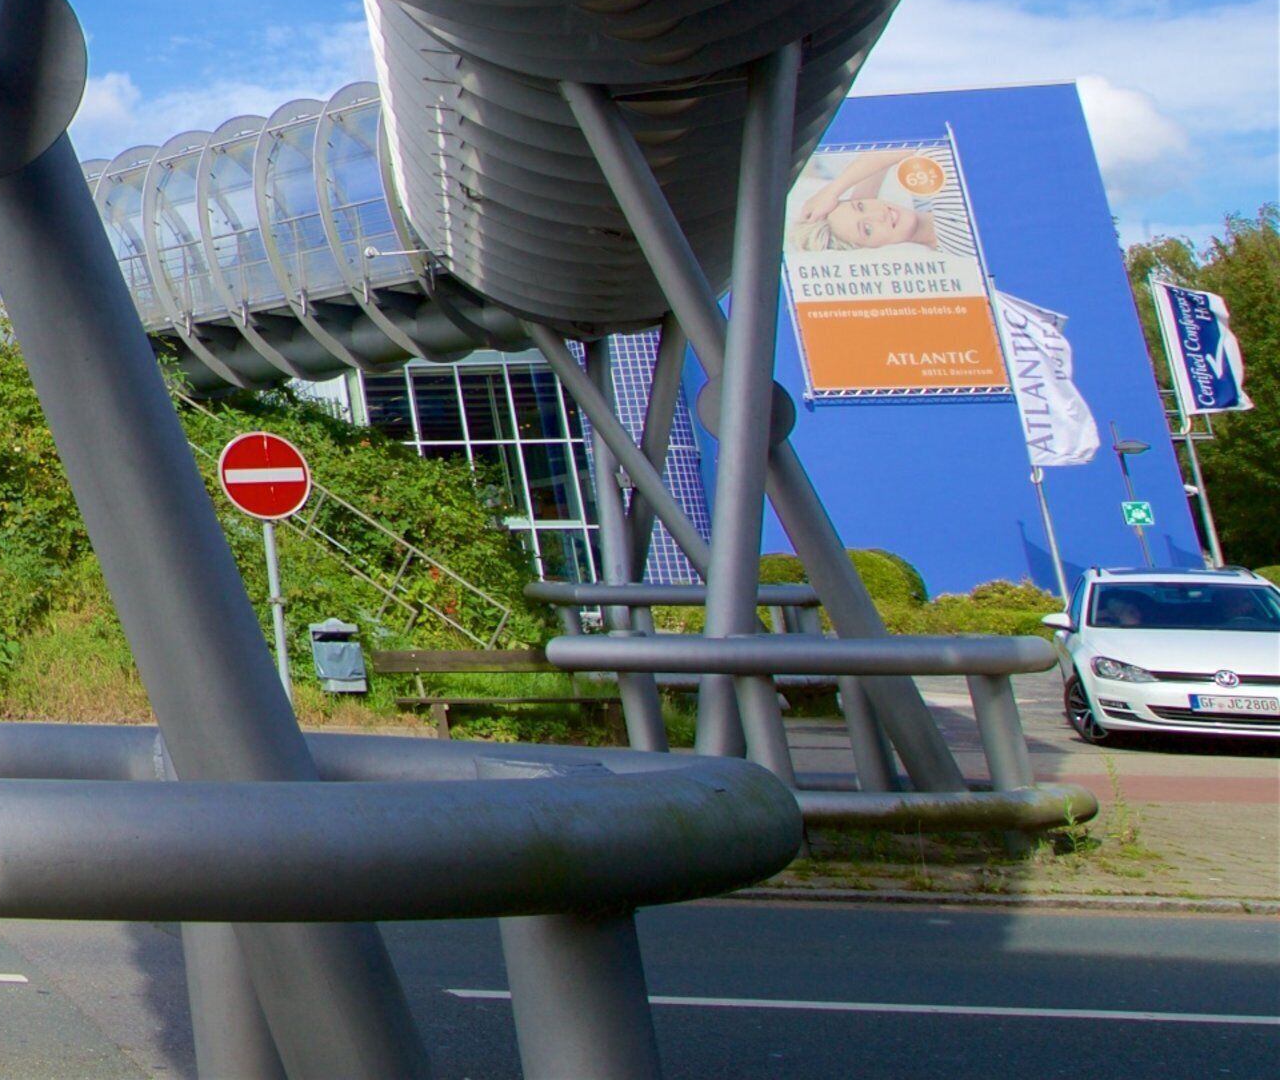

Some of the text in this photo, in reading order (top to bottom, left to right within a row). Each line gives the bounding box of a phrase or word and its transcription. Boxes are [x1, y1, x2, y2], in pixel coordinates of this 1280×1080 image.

[799, 261, 947, 279] GANZ ENTSPANNT
[802, 278, 963, 297] ECONOMY BUCHEN
[807, 305, 968, 320] reservierung@atlantic-hotels.de
[886, 349, 981, 366] ATLANTIC
[1003, 309, 1057, 455] ATLANTIC
[1186, 353, 1216, 407] Certified
